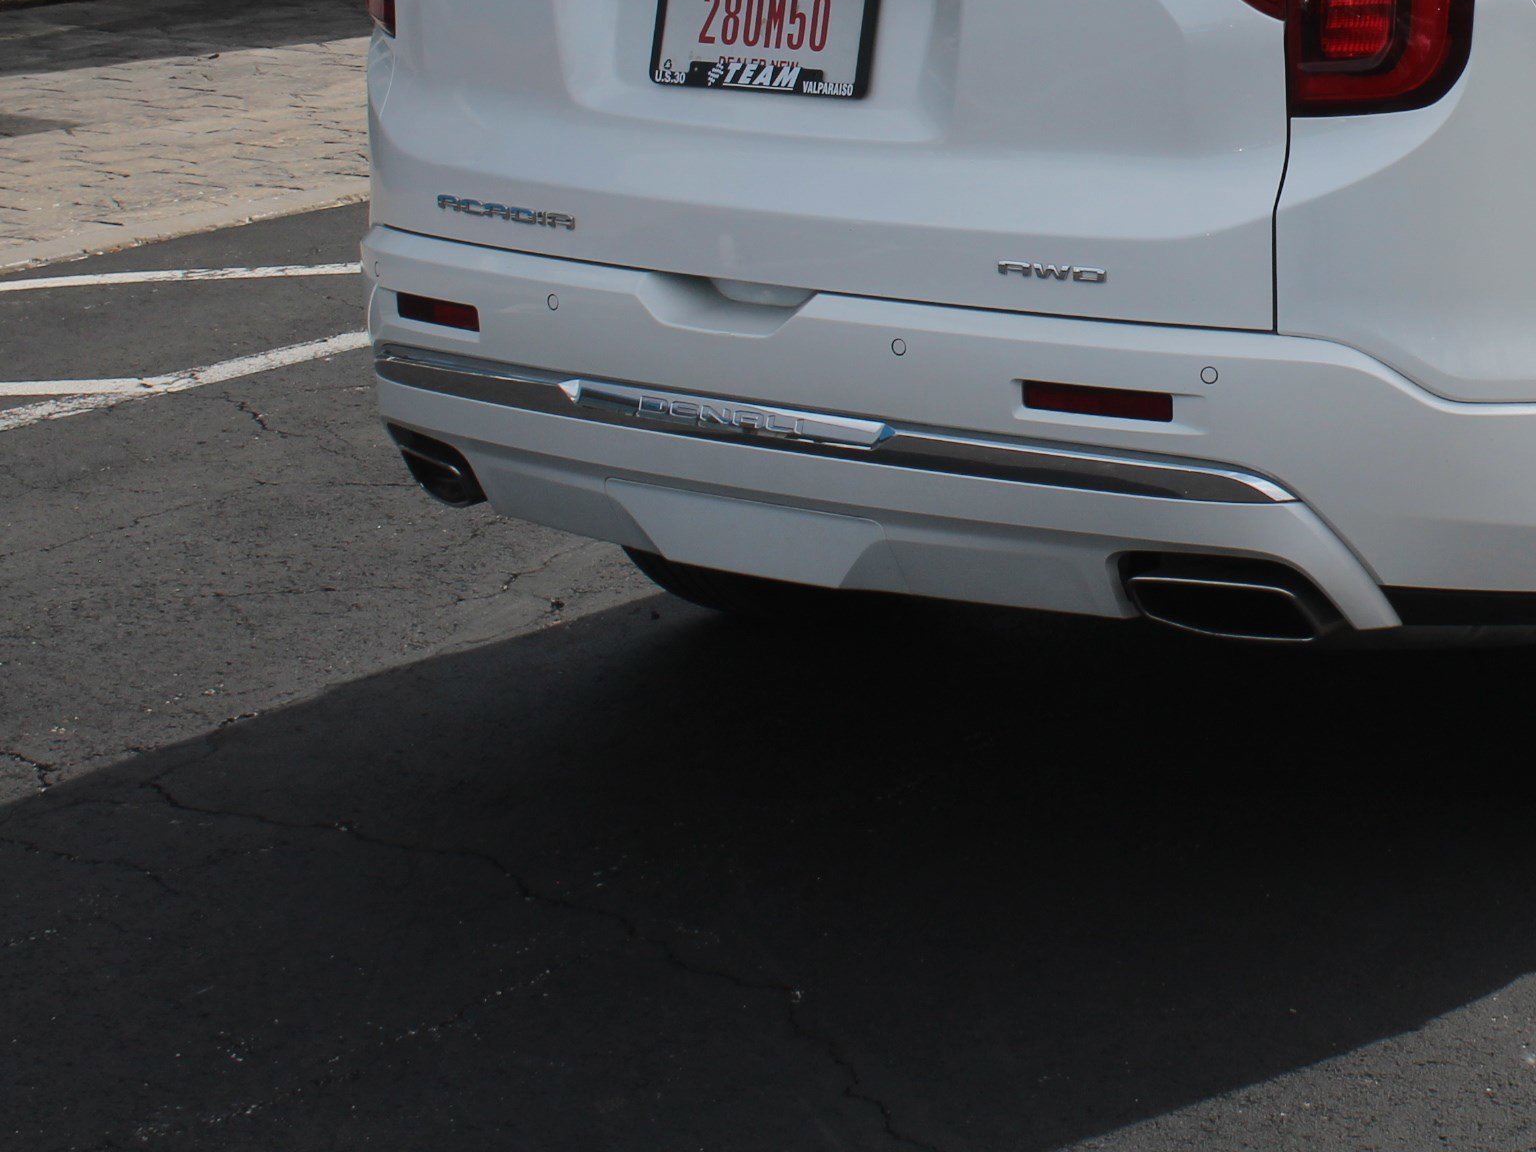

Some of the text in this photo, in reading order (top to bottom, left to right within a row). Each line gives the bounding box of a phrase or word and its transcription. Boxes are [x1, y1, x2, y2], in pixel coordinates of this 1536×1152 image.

[723, 61, 802, 86] TEAM
[802, 80, 854, 97] VALPARAISO
[436, 193, 577, 231] ACADIA
[997, 259, 1108, 285] AWD
[636, 394, 806, 436] DENALI
